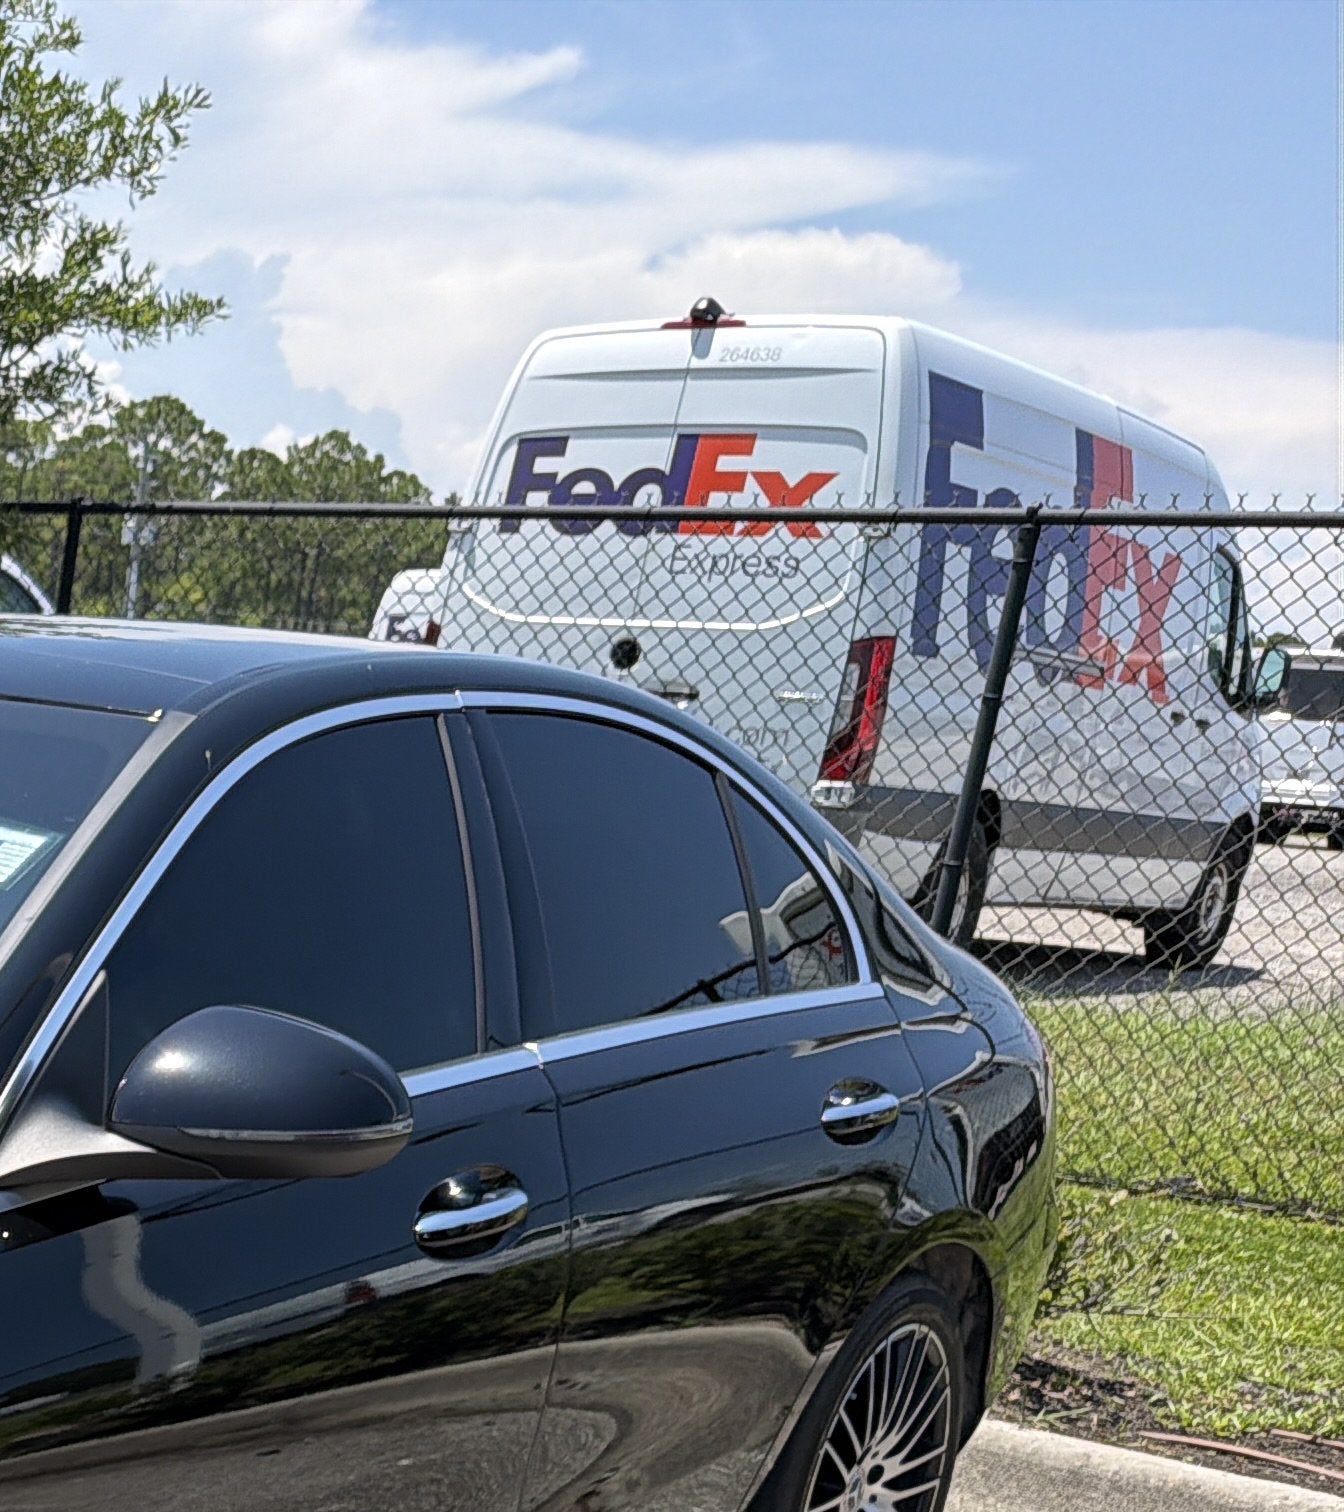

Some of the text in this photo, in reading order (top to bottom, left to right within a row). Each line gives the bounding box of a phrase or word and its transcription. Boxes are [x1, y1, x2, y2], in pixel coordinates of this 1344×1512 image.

[719, 347, 783, 363] 264638
[498, 433, 839, 538] FedEx
[666, 544, 800, 582] Express
[911, 371, 1185, 704] FedEx
